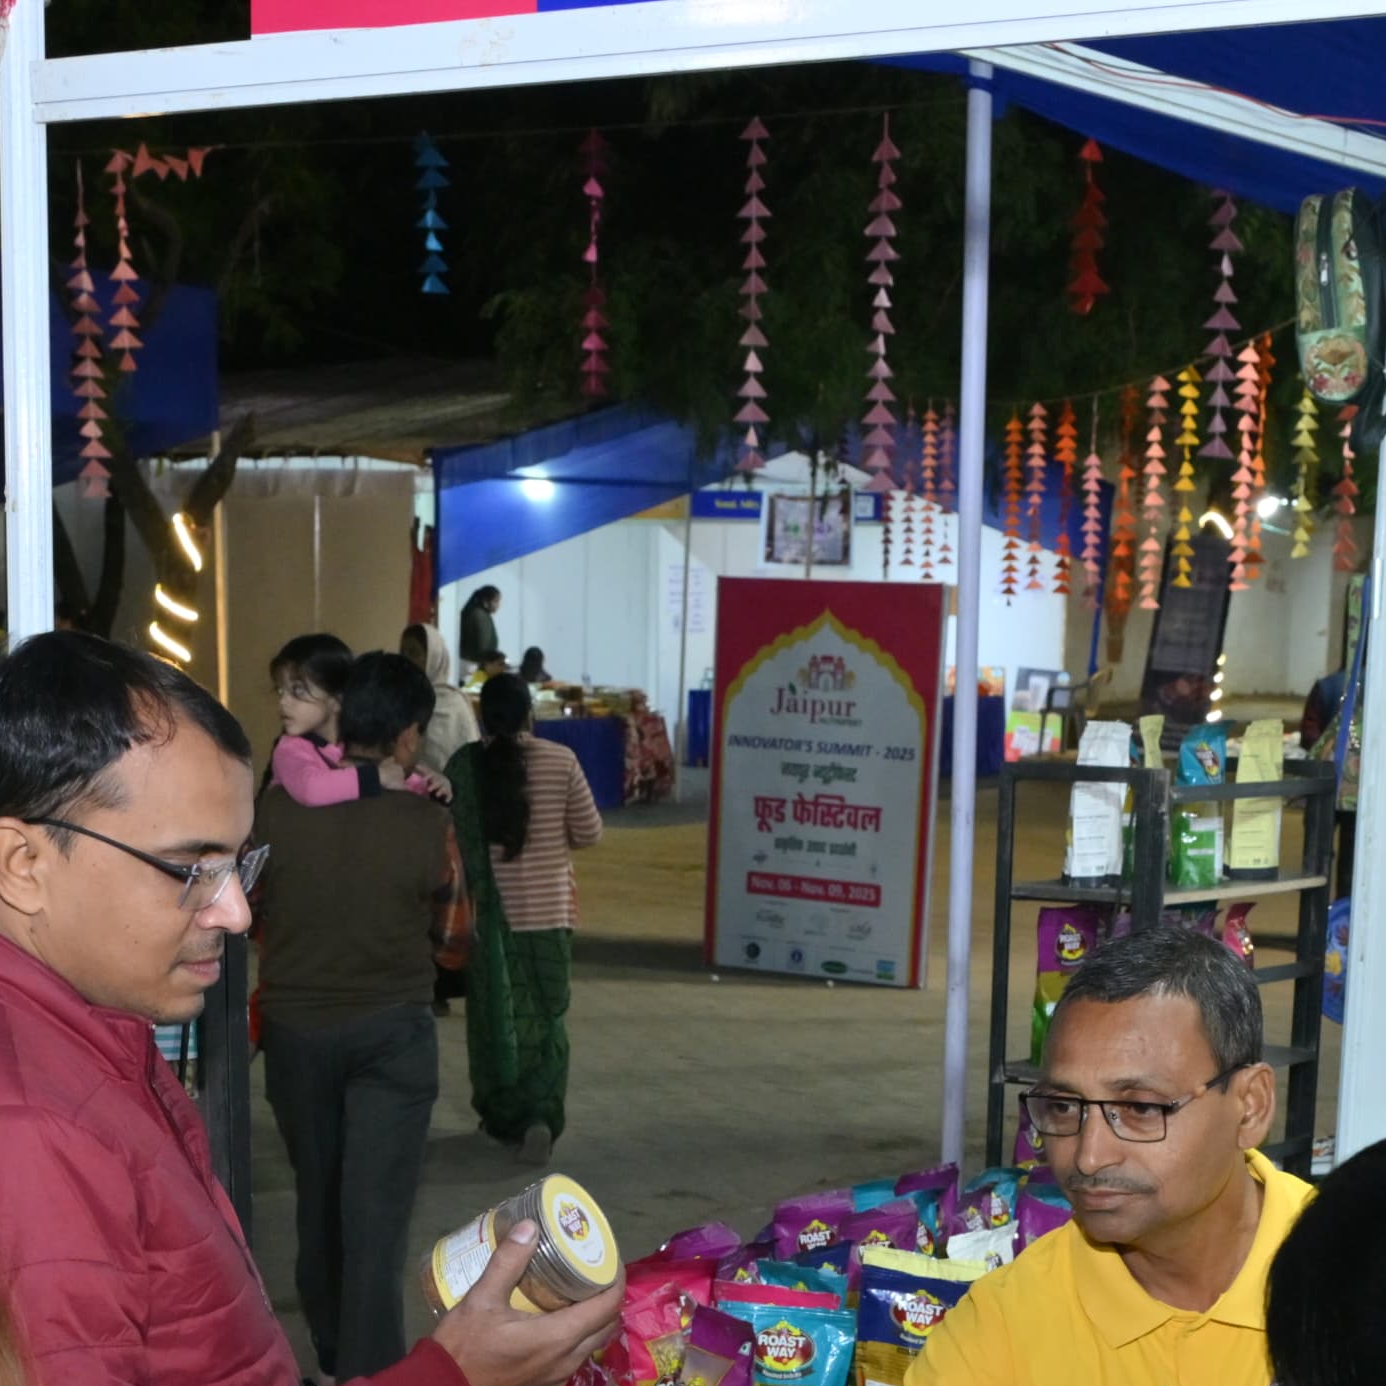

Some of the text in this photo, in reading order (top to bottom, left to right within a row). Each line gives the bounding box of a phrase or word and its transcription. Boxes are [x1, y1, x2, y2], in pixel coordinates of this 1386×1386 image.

[770, 686, 857, 724] Jaipur
[727, 734, 916, 762] INNOVATOR'S SUMMIT 2025
[753, 791, 883, 834] फूड फेस्टिवल
[799, 1231, 831, 1245] ROAST
[898, 1300, 944, 1316] ROAST
[906, 1311, 933, 1325] WAY
[758, 1334, 807, 1349] ROAST
[766, 1346, 797, 1359] WAY
